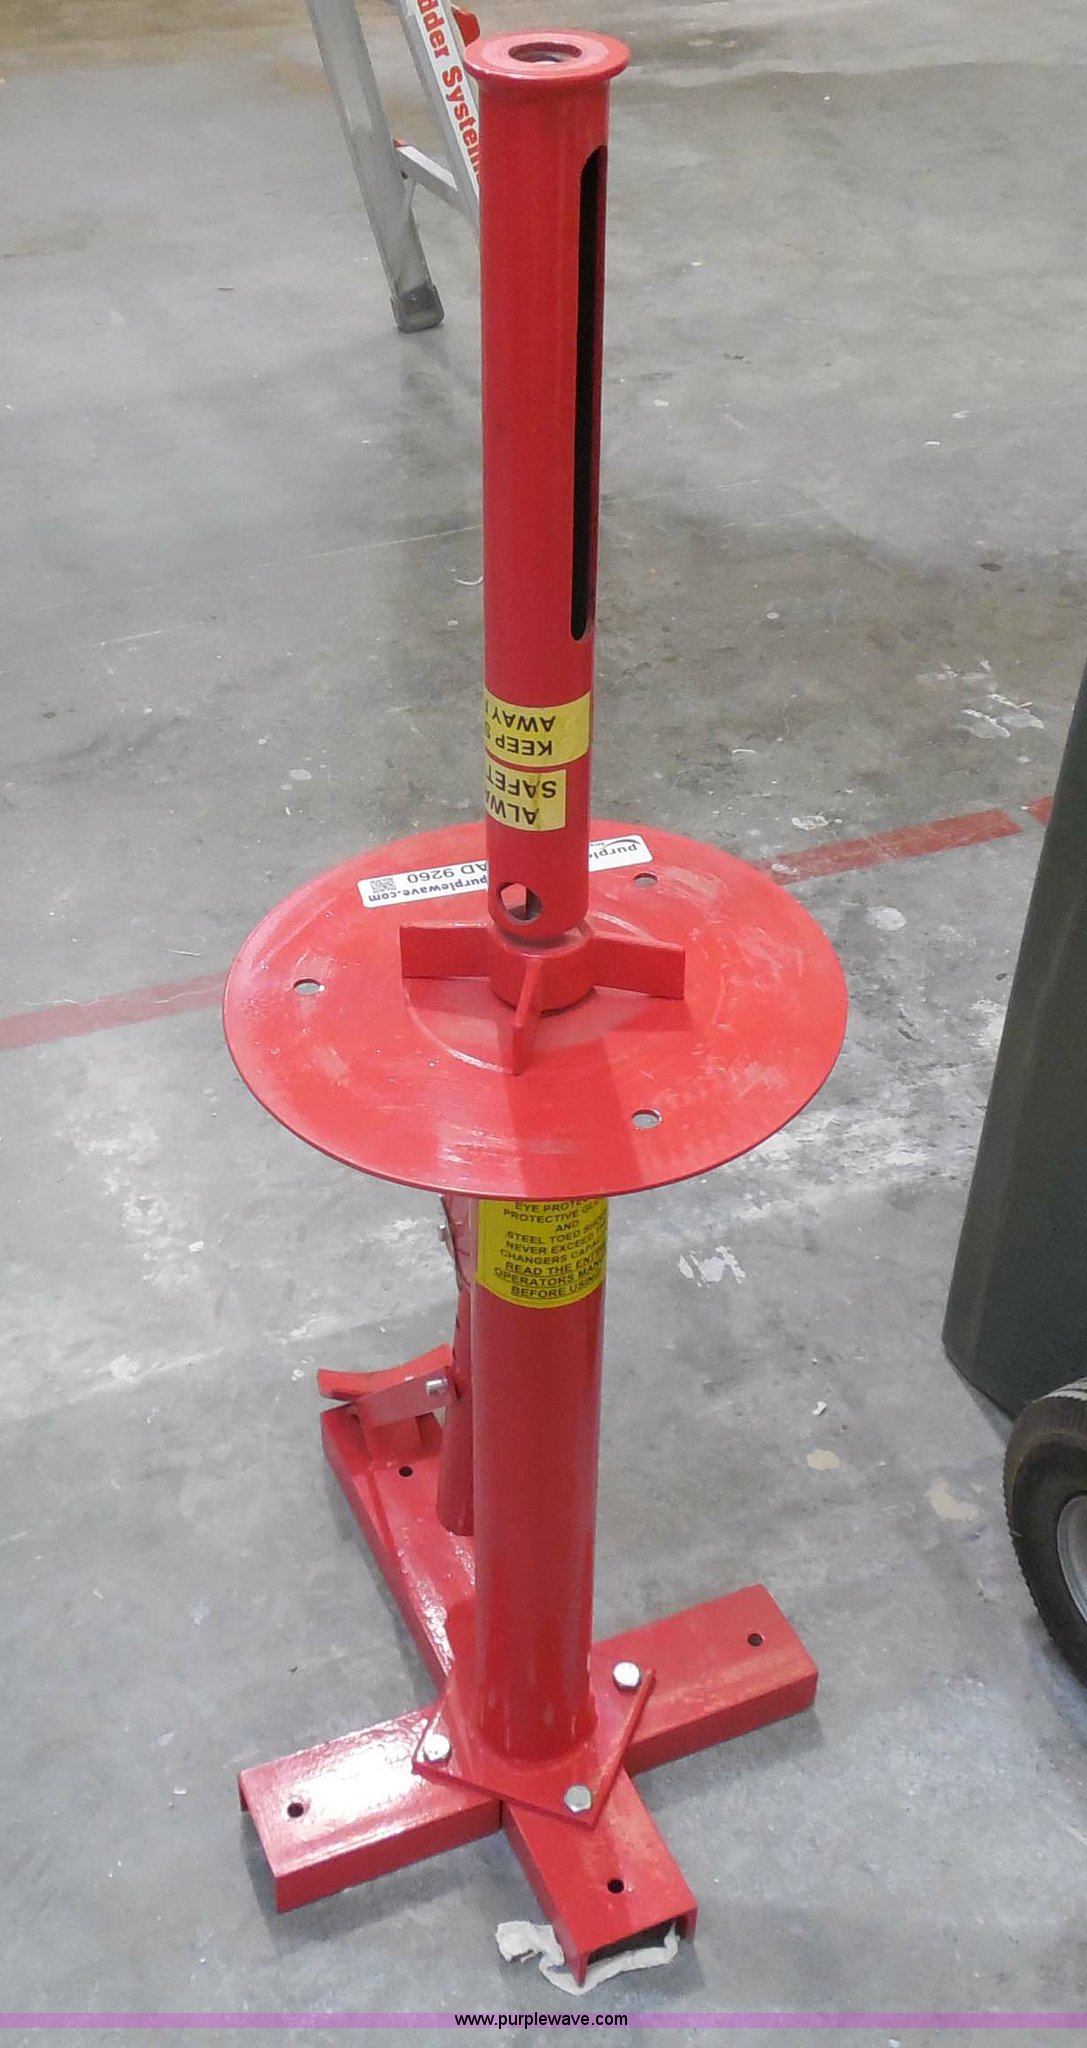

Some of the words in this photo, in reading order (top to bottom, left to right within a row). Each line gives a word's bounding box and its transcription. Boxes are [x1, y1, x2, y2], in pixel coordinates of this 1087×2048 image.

[417, 0, 450, 59] dder
[492, 706, 556, 732] AWAY
[495, 734, 553, 756] KEEP
[487, 765, 557, 799] SAFET
[407, 868, 455, 883] 9260
[368, 875, 487, 902] purplewave.com
[515, 1201, 539, 1213] EYE
[503, 1208, 580, 1223] PROTECTIVE
[555, 1220, 580, 1232] AND
[507, 1231, 544, 1244] STEEL
[549, 1230, 581, 1243] TOED
[506, 1241, 547, 1254] NEVER
[500, 1249, 567, 1265] CHANGERS
[506, 1261, 542, 1275] READ
[548, 1263, 572, 1275] THE
[494, 1267, 574, 1286] OPERATORS
[511, 1285, 565, 1298] BEFORE
